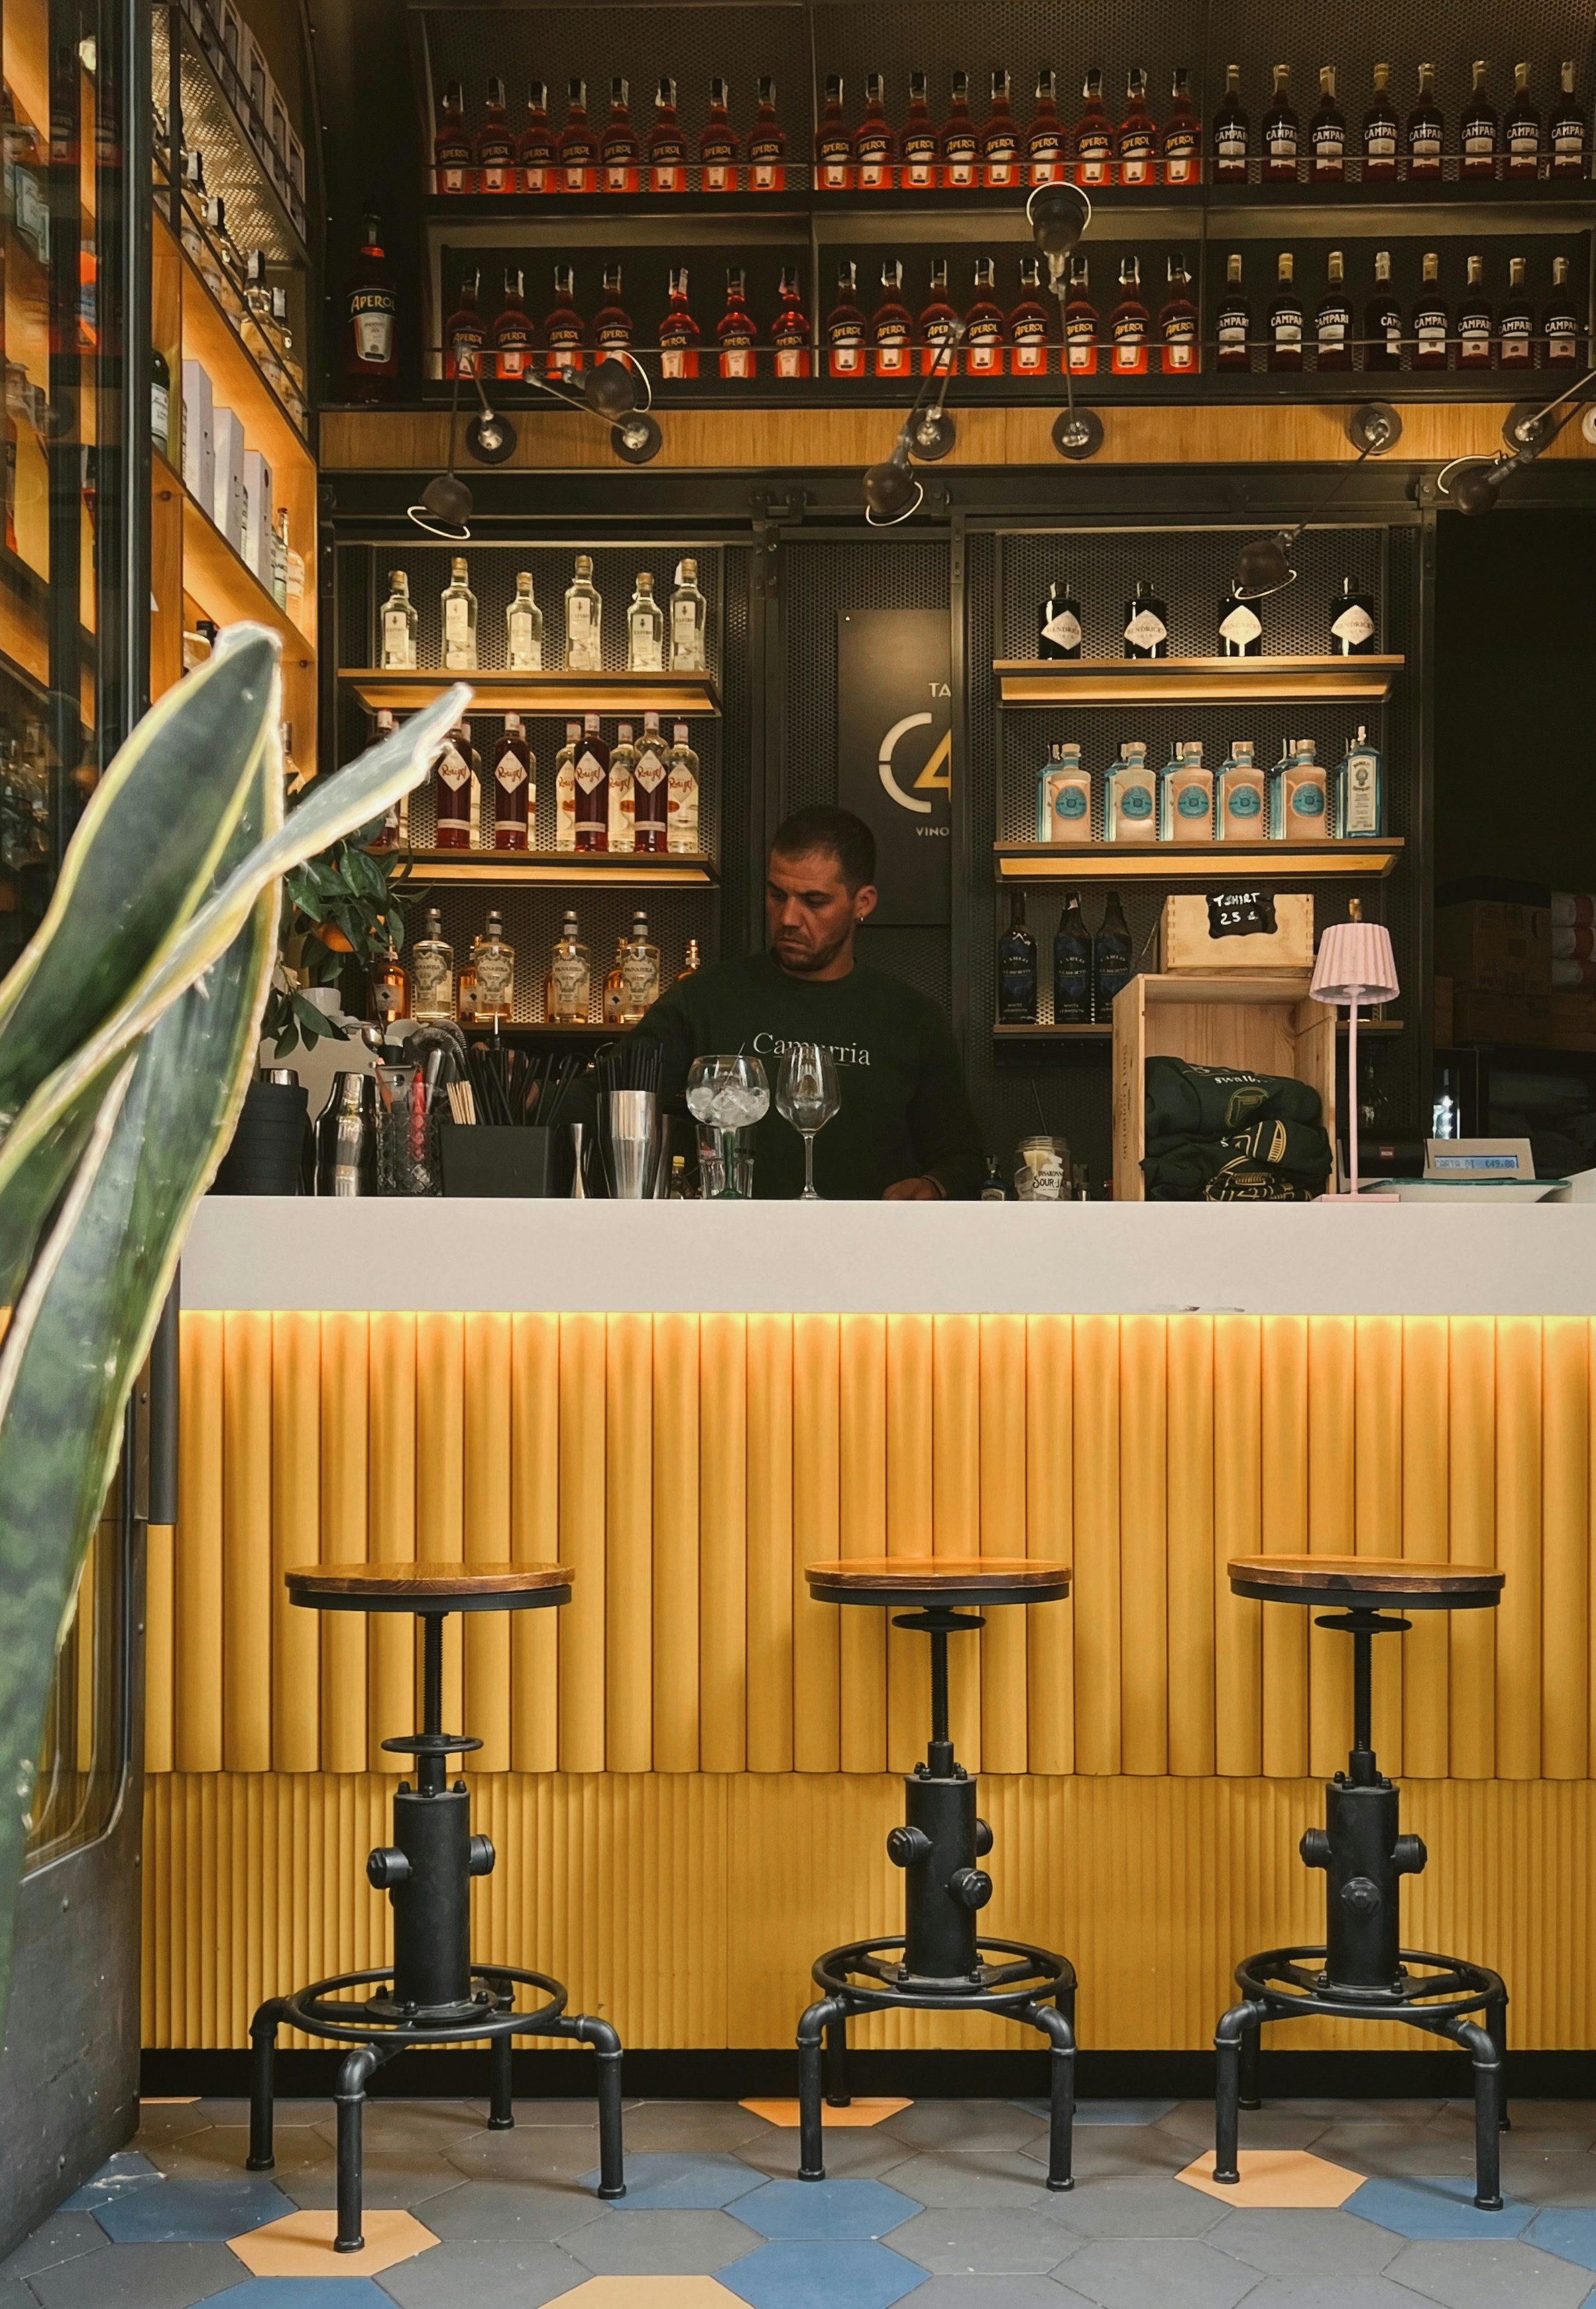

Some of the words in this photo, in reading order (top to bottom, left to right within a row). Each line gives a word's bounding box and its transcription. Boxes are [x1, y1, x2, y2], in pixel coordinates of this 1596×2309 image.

[858, 141, 886, 153] APEROL
[905, 140, 934, 153] APEROL
[946, 139, 976, 153] APEROL
[986, 139, 1015, 151] APEROL
[1030, 137, 1058, 152] APEROL
[1078, 137, 1109, 150] APEROL
[1121, 136, 1150, 149] APEROL
[1165, 135, 1194, 148] APEROL
[821, 142, 849, 155] APEROL
[351, 295, 396, 314] APEROL
[832, 326, 862, 339] APEROL
[876, 325, 906, 338] APEROL
[968, 323, 999, 336] APEROL
[1014, 323, 1045, 336] APEROL
[1066, 323, 1094, 336] APEROL
[1114, 322, 1145, 335] APEROL
[1165, 322, 1194, 337] APEROL
[498, 331, 528, 344] APEROL
[549, 330, 579, 341] APEROL
[600, 329, 630, 342] APEROL
[915, 826, 950, 837] VINO
[1220, 911, 1241, 926] 25
[1033, 1175, 1055, 1188] SOUR
